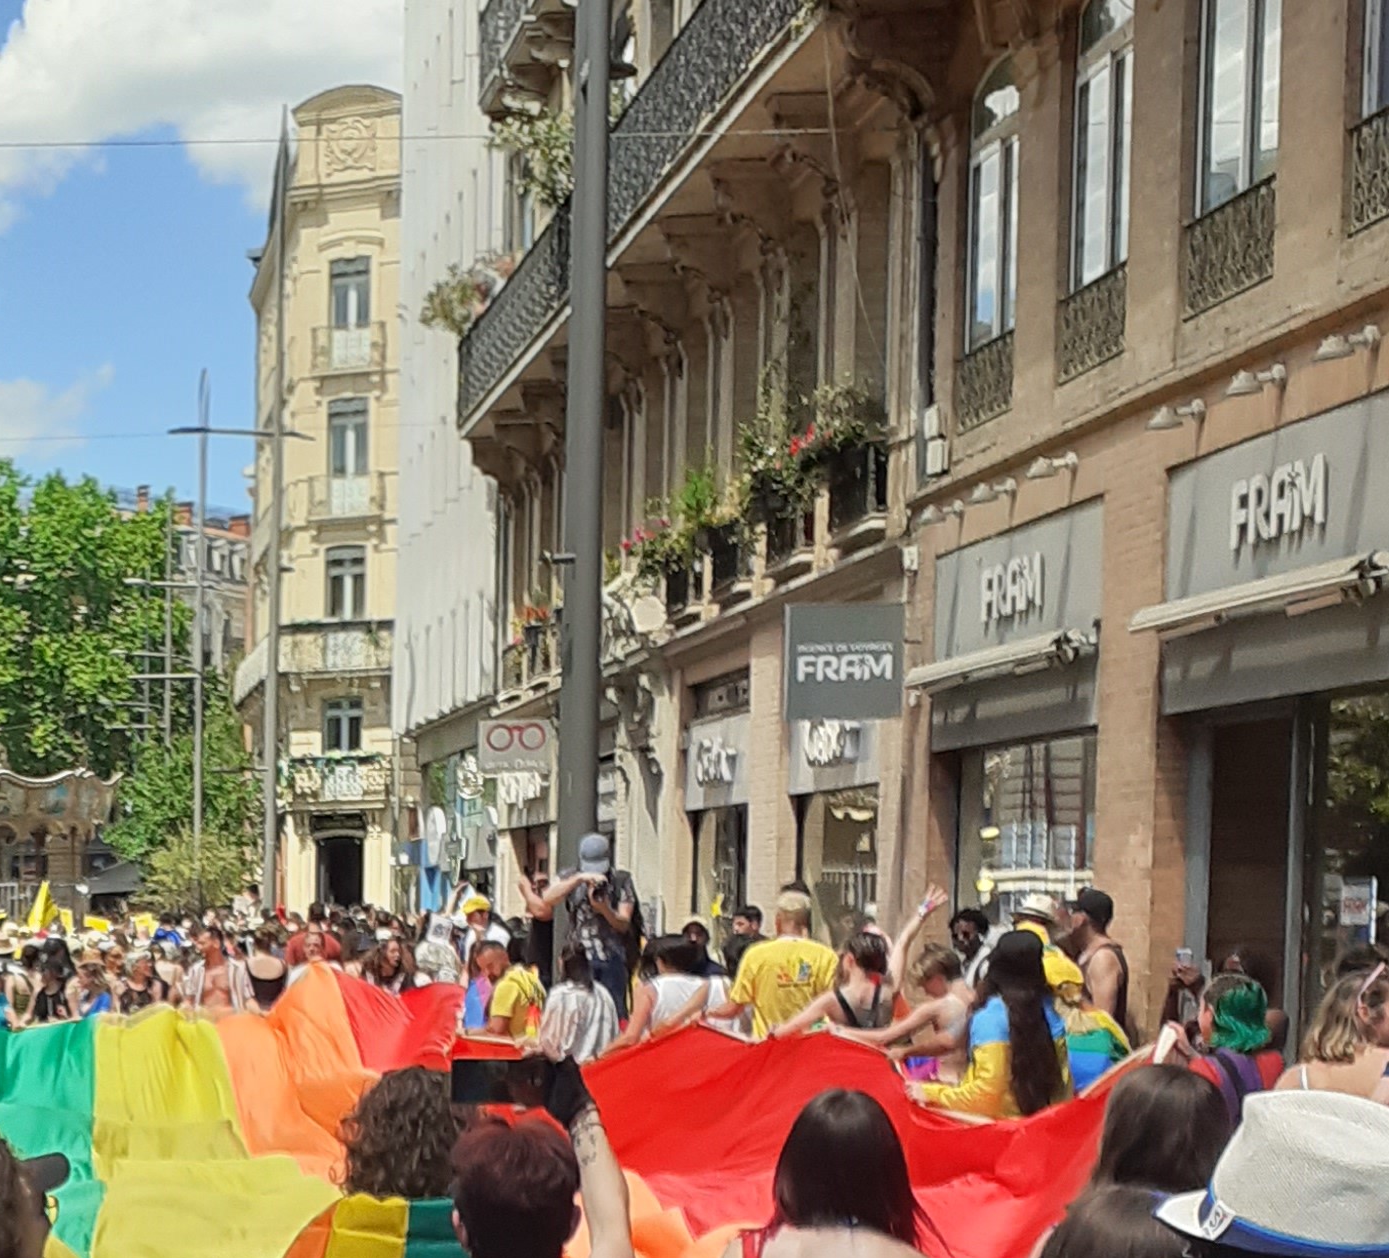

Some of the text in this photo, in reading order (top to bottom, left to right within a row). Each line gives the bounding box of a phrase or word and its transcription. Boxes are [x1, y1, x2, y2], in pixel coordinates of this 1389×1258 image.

[1230, 453, 1327, 549] FRAM
[980, 551, 1044, 622] FRAM
[796, 653, 893, 682] FRAM
